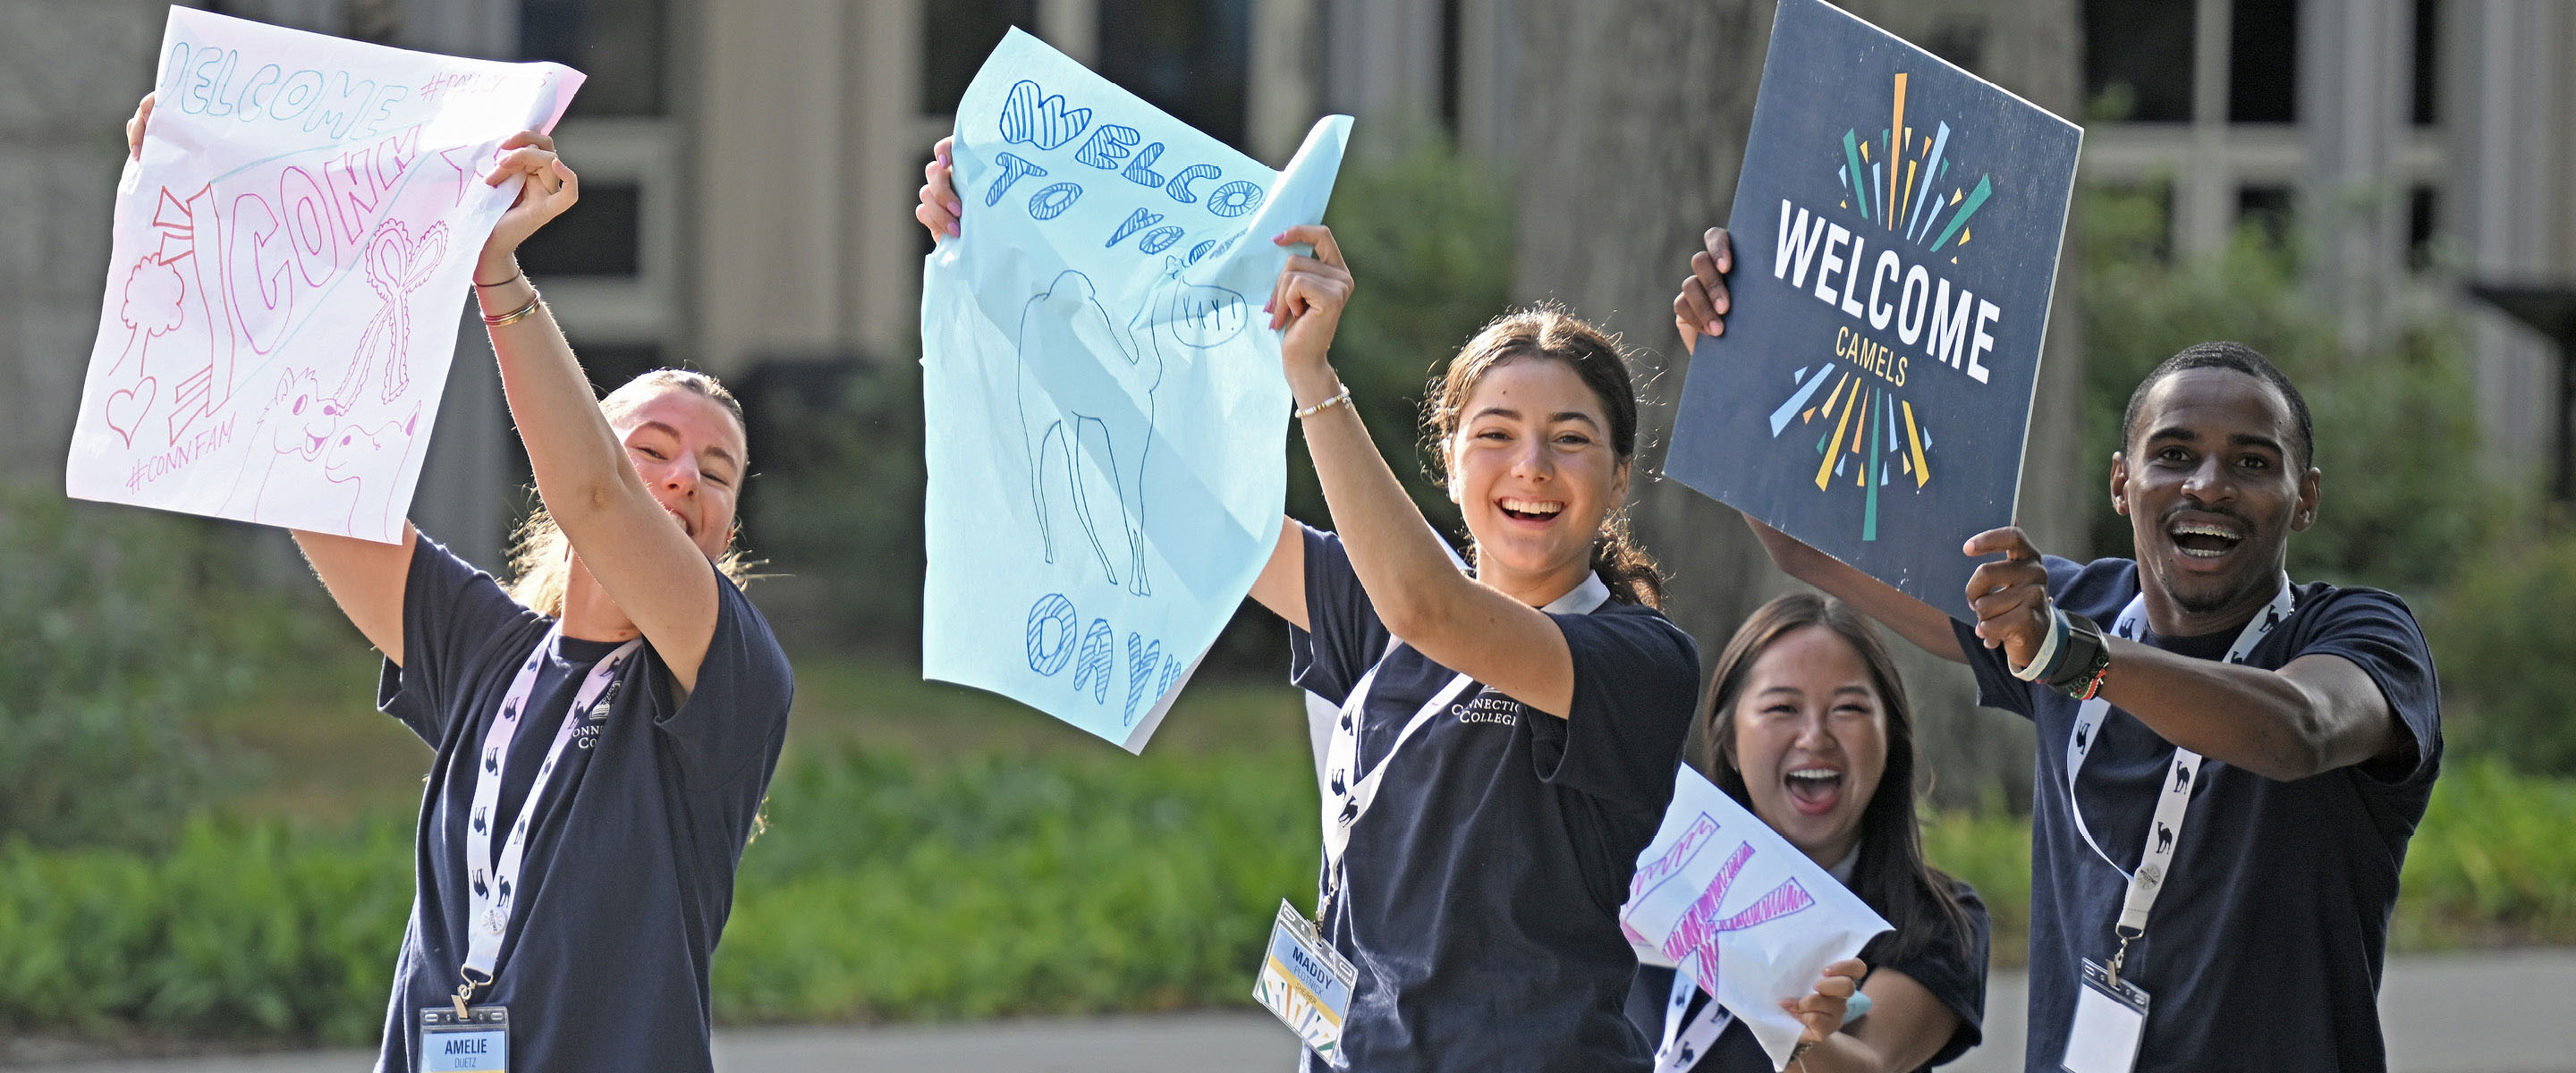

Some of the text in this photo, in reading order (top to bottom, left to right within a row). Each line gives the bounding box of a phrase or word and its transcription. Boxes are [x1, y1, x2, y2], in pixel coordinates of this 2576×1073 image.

[999, 80, 1264, 216] WELCO
[985, 151, 1083, 221] TO
[1775, 199, 2001, 384] WELCOME
[1182, 295, 1237, 332] YAY!
[1835, 325, 1908, 387] CAMELS
[1451, 698, 1520, 716] CNNECTI
[1292, 946, 1333, 990] MADDY
[1293, 965, 1324, 999] PLOTNICK
[445, 1038, 487, 1054] AMELIE
[454, 1056, 477, 1069] DUETZ
